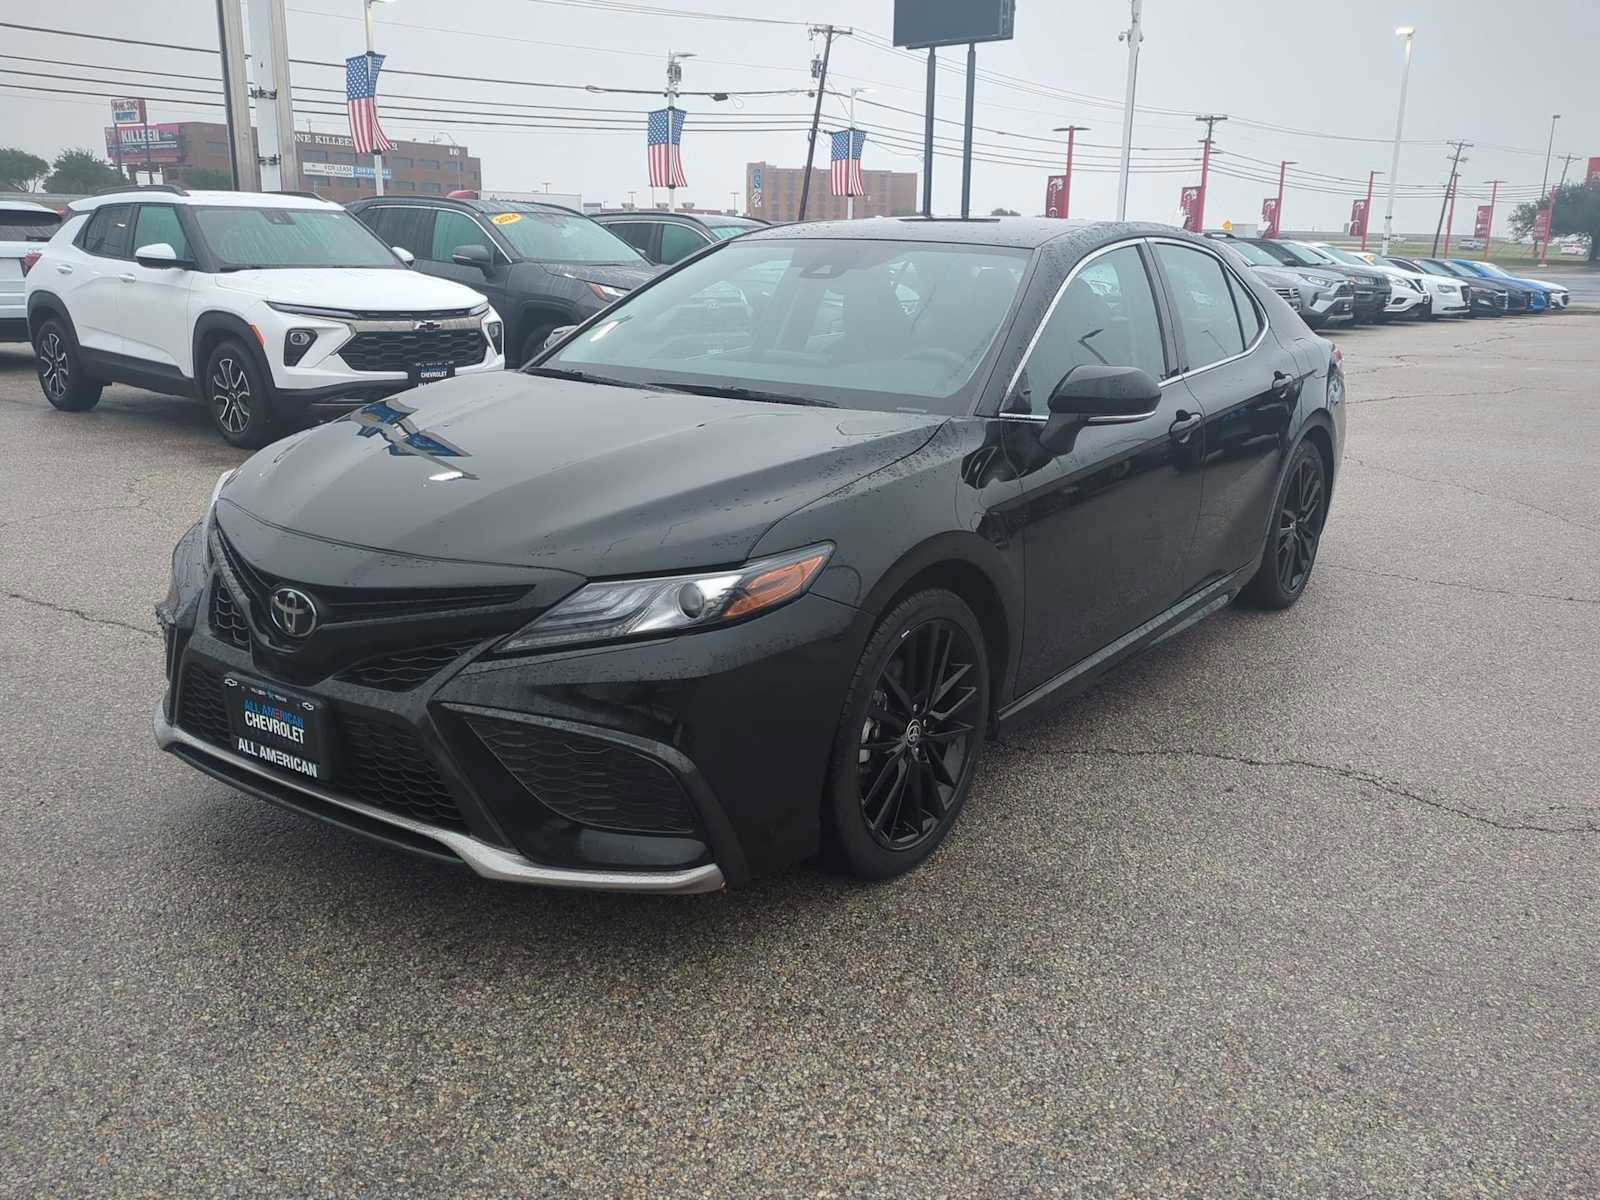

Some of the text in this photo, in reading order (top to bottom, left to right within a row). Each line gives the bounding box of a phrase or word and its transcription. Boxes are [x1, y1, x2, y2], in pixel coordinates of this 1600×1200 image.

[121, 129, 160, 142] KILLEEN
[315, 135, 353, 146] KILLEE
[244, 699, 304, 728] ALL AMERICAN
[244, 711, 304, 744] CHEVROLET
[238, 738, 318, 778] ALL AMERICAN
